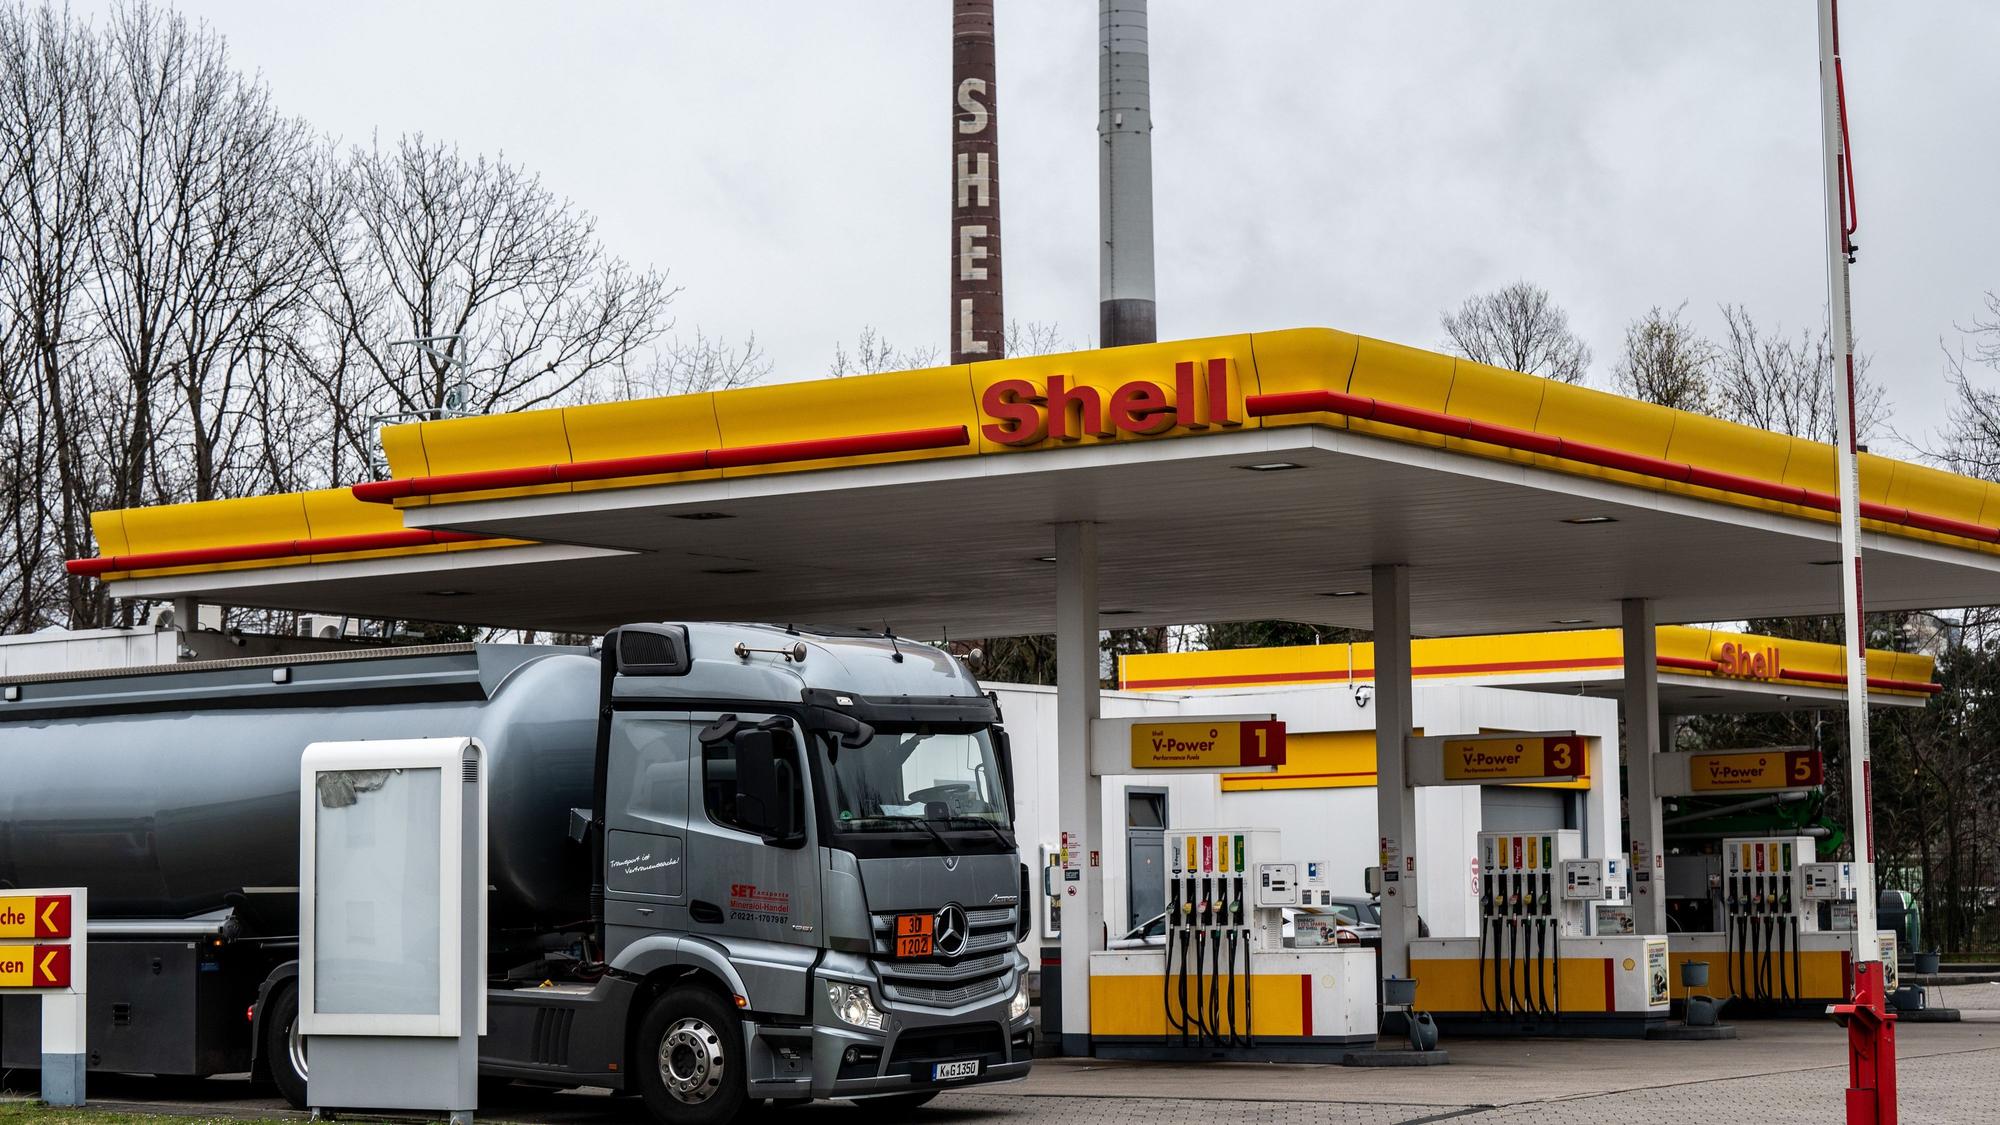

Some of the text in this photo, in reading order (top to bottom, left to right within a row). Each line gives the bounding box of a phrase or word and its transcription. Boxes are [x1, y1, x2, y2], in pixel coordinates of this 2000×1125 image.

[981, 358, 1230, 447] Shell
[1722, 642, 1780, 679] Shell
[1152, 728, 1267, 758] V-Power 1
[1463, 743, 1572, 770] V-Power 3
[1709, 757, 1811, 780] V-Power 5
[0, 906, 26, 925] che
[909, 918, 922, 933] 30
[902, 937, 928, 955] 1202
